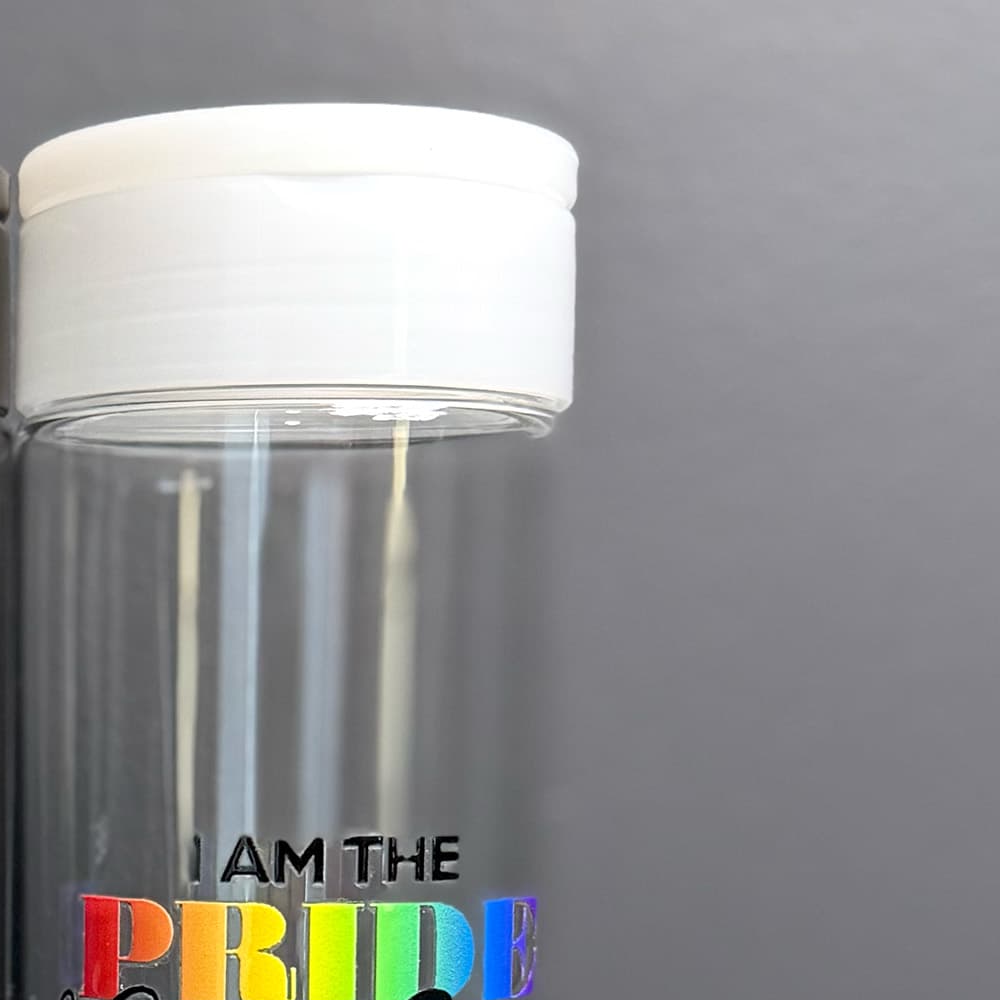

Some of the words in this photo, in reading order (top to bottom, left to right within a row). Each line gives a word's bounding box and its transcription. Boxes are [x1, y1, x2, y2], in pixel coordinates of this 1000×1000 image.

[192, 834, 203, 882] I
[220, 834, 325, 883] AM
[343, 834, 460, 881] THE
